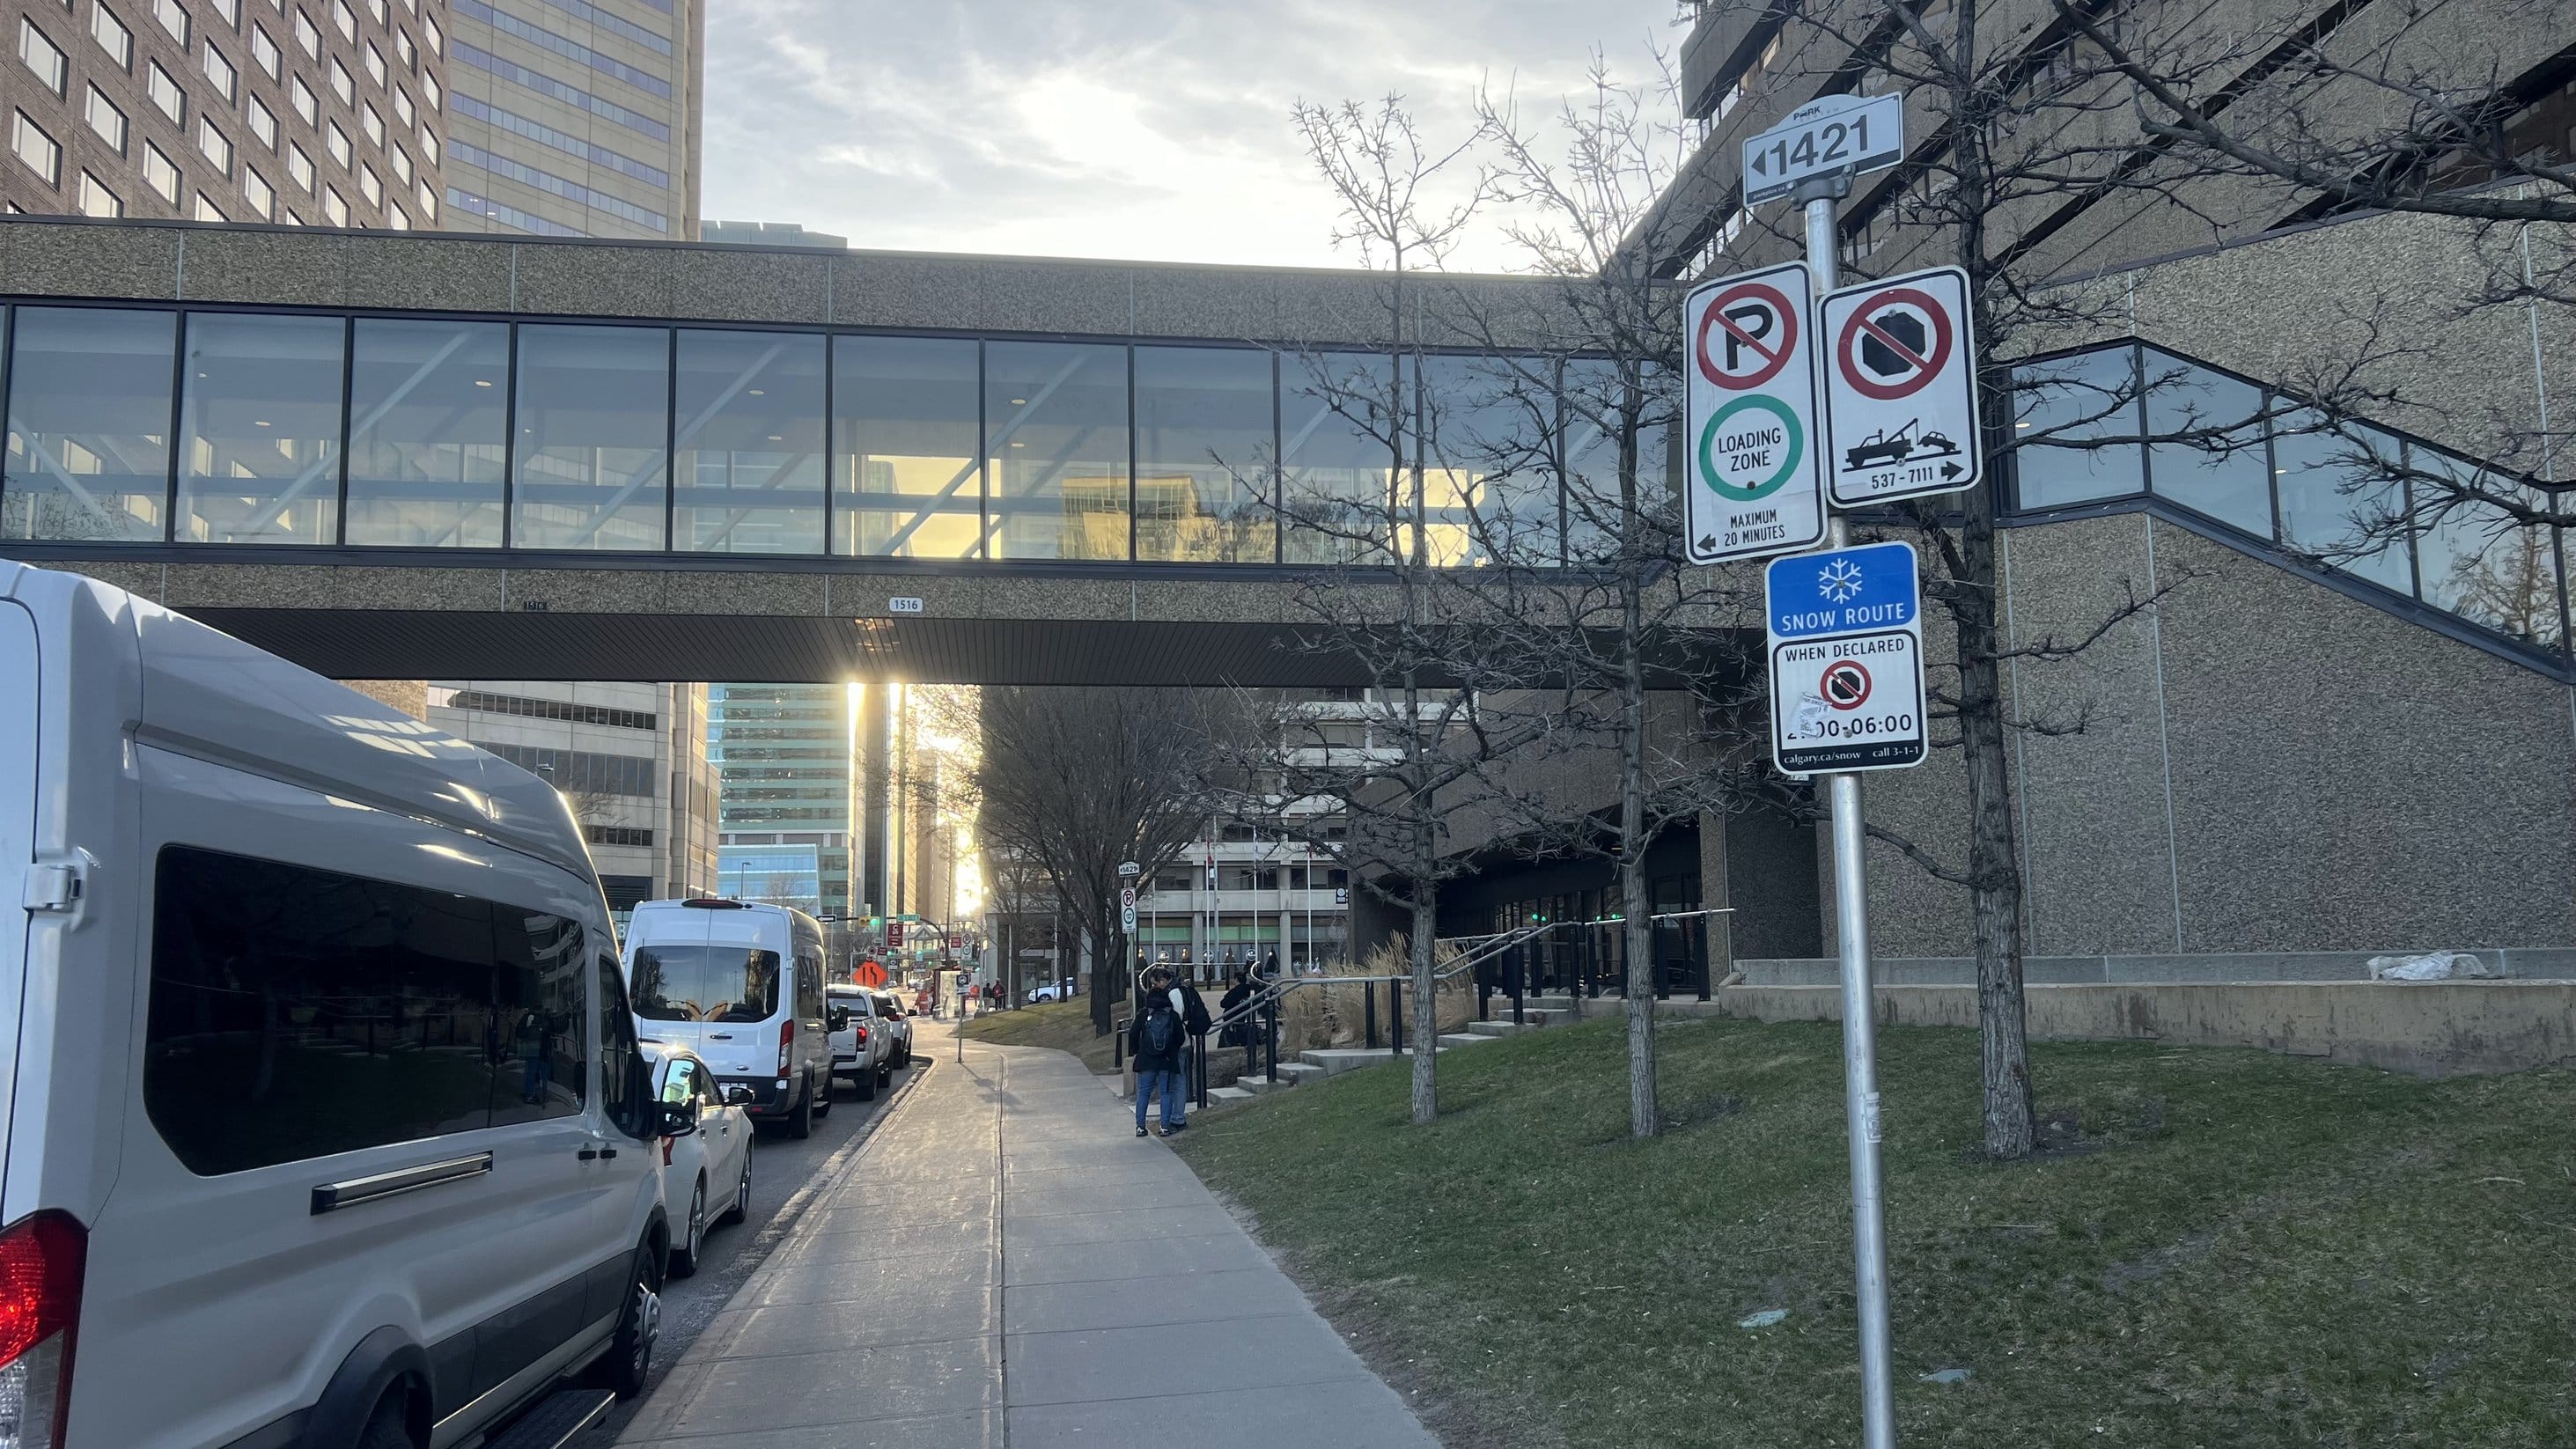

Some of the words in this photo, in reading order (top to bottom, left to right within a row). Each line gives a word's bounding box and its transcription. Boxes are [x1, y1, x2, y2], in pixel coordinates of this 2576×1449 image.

[1770, 114, 1868, 175] 1421
[1719, 428, 1781, 453] LOADING
[1731, 450, 1770, 472] ZONE
[1731, 509, 1777, 528] MAXIMUM
[1725, 533, 1738, 547] 20
[1742, 525, 1785, 544] MINUTES
[894, 599, 918, 610] 1516
[1782, 610, 1836, 631] SNOW
[1845, 603, 1905, 624] ROUTE
[1785, 646, 1826, 662] WHEN
[1834, 638, 1904, 658] DECLARED
[1784, 751, 1862, 766] calgary.ca/snow
[1873, 747, 1889, 758] call
[1893, 747, 1919, 756] 3-1-1
